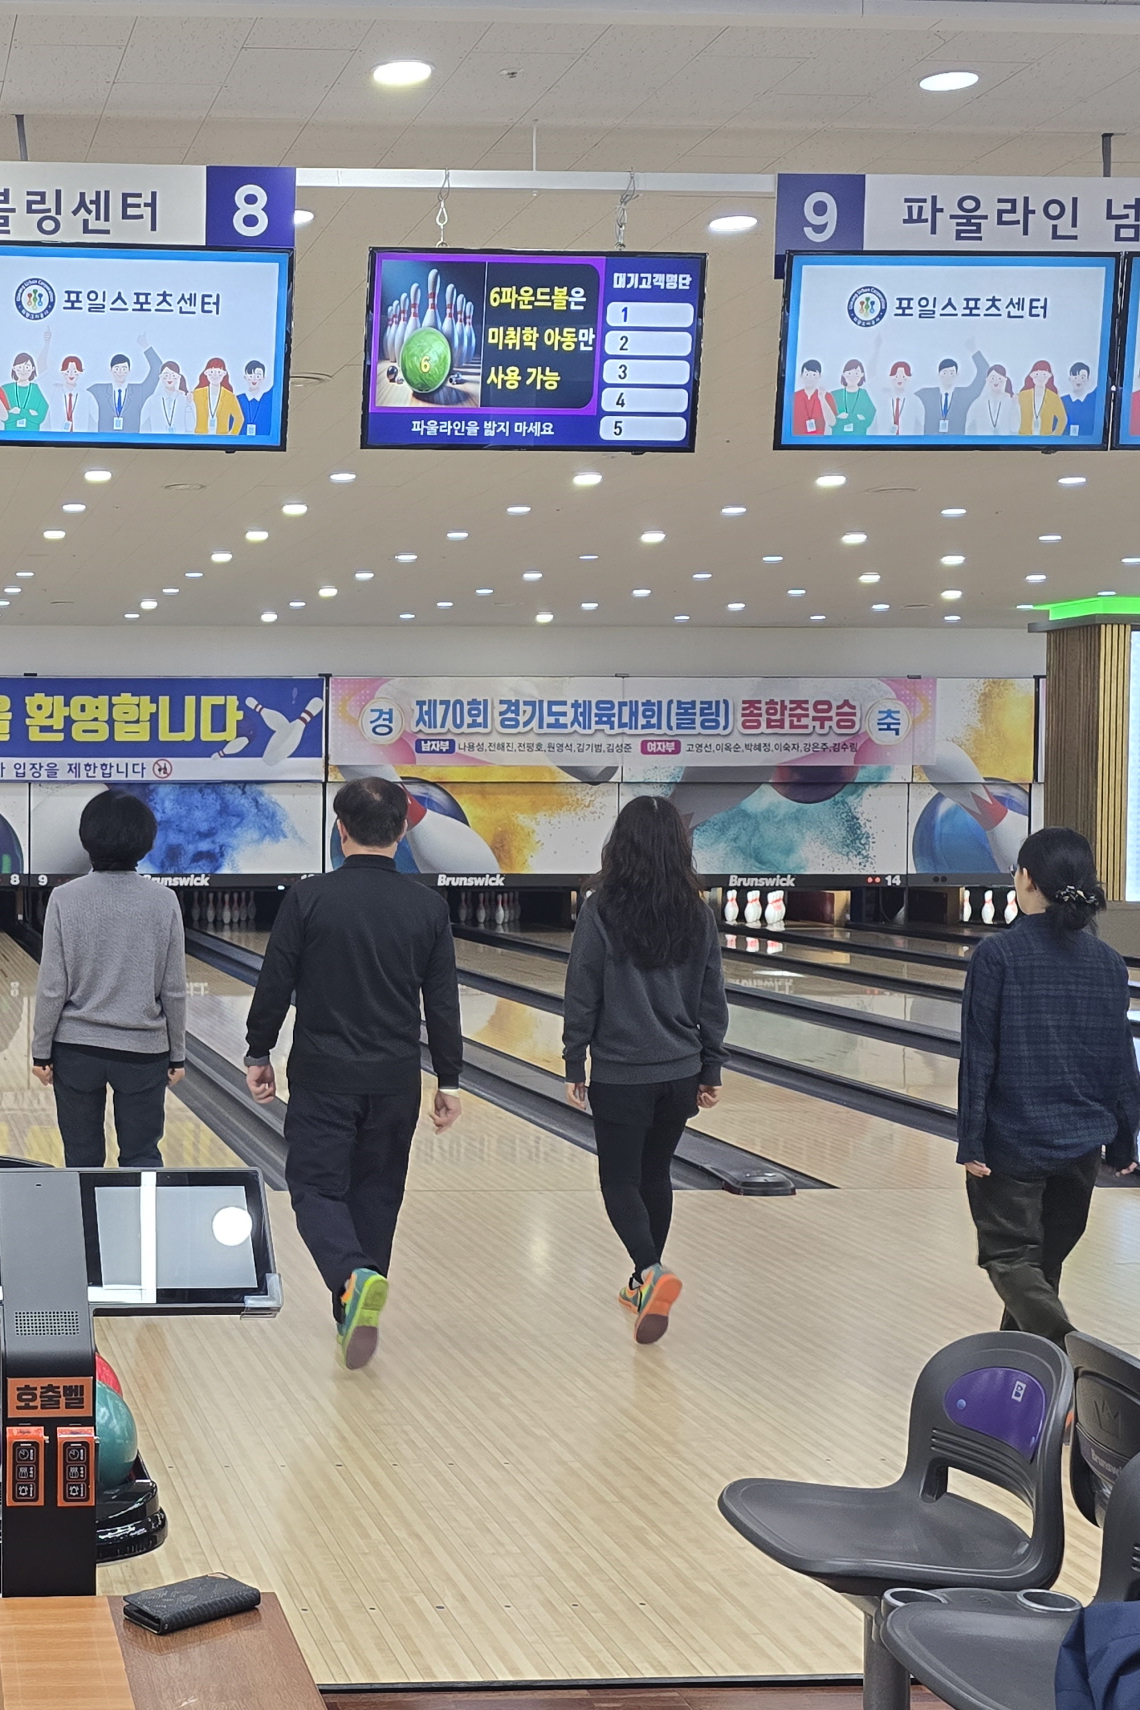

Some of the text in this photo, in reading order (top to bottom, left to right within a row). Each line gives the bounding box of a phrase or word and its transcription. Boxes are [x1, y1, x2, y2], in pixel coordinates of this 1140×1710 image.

[232, 183, 269, 237] 8
[803, 191, 838, 243] 9
[902, 194, 1079, 242] 파울라인
[612, 272, 692, 290] 대기고객명단
[62, 289, 221, 315] 포일스포츠센터
[489, 285, 587, 311] 6파운드볼은
[621, 306, 629, 322] 1
[893, 295, 1048, 320] 포일스포츠센터
[487, 327, 595, 351] 미취학 아동만
[619, 336, 629, 351] 2
[487, 366, 561, 389] 사용 가능
[618, 364, 628, 380] 3
[615, 392, 626, 408] 4
[411, 420, 555, 437] 파울라인을 밟지 마세요
[613, 420, 623, 436] 5
[25, 692, 244, 742] 환영합니다
[369, 707, 395, 737] 경
[415, 698, 858, 731] 제70회 경기도체육대회(볼링) 종합준우승
[876, 708, 902, 737] 축
[420, 740, 451, 753] 남자부
[646, 741, 676, 753] 여자부
[13, 761, 59, 778] 입장을
[66, 761, 147, 779] 제한합니다
[10, 874, 20, 886] 8
[38, 875, 48, 886] 9
[437, 874, 505, 887] Brunswick
[728, 874, 796, 887] Brunswick
[885, 875, 901, 887] 14
[15, 1383, 85, 1411] 호출벨
